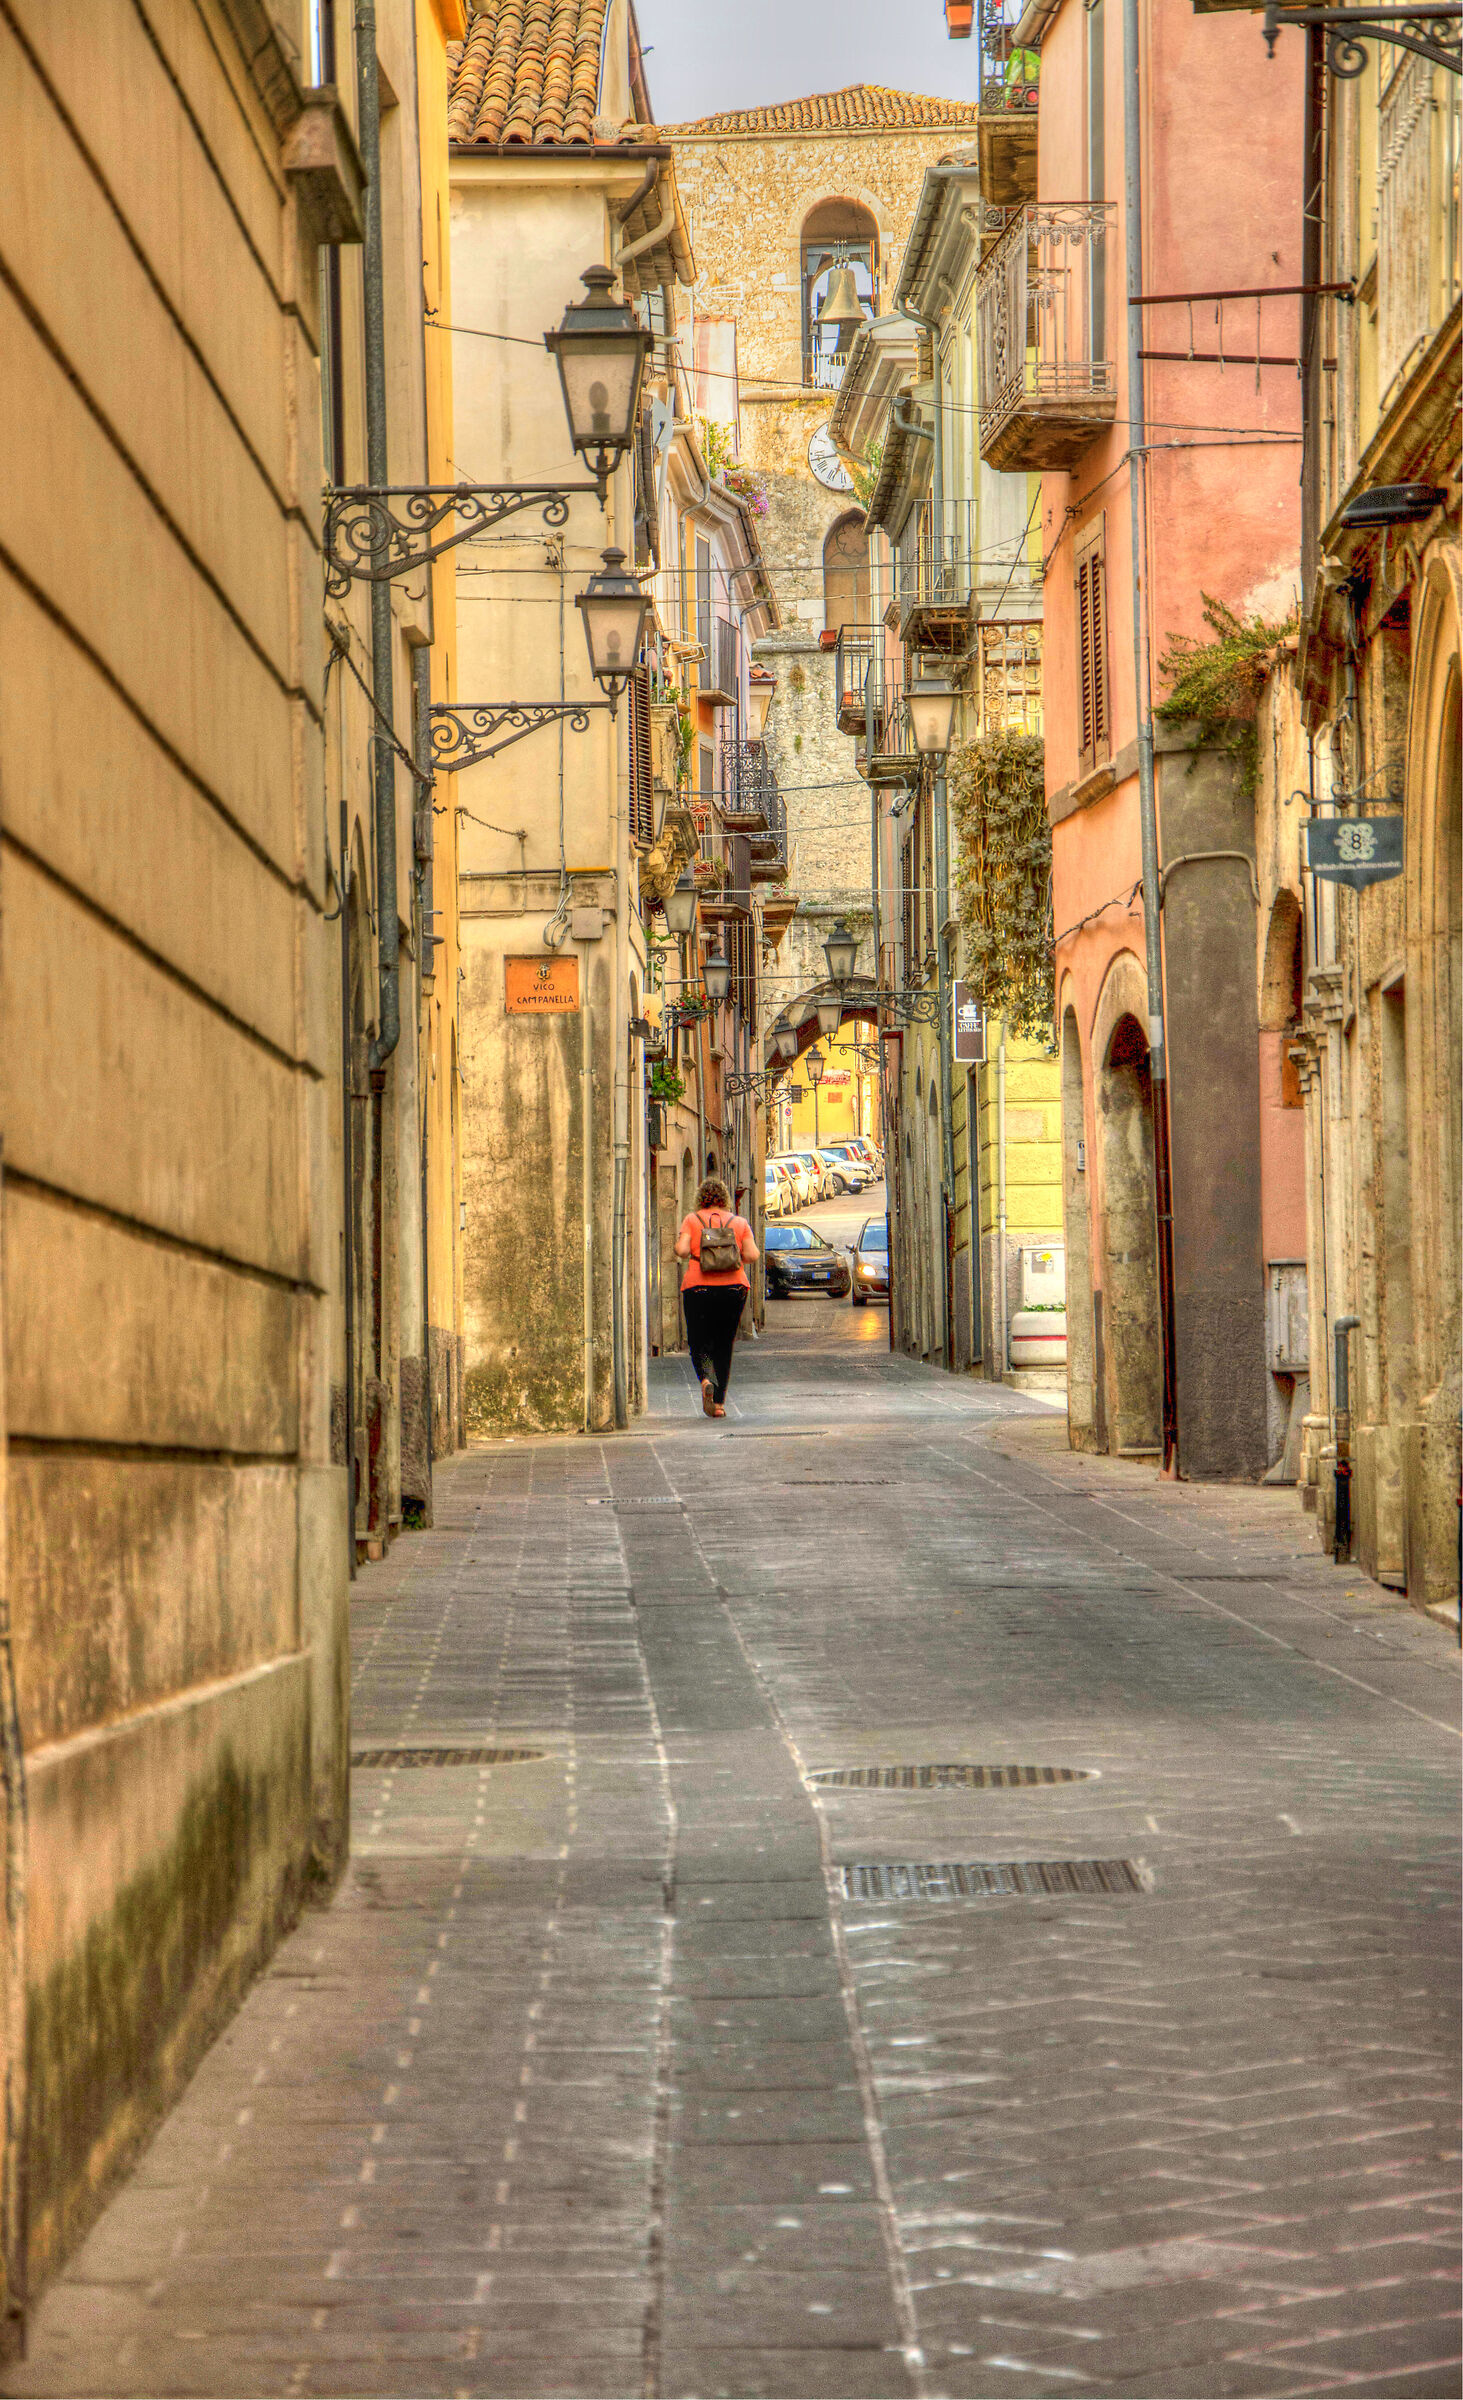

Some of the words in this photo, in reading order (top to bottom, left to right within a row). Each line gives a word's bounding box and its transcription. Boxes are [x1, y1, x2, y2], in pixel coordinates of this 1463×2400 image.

[1351, 833, 1361, 850] 8
[533, 983, 555, 991] VICO
[516, 995, 574, 1004] CAMPANELLA
